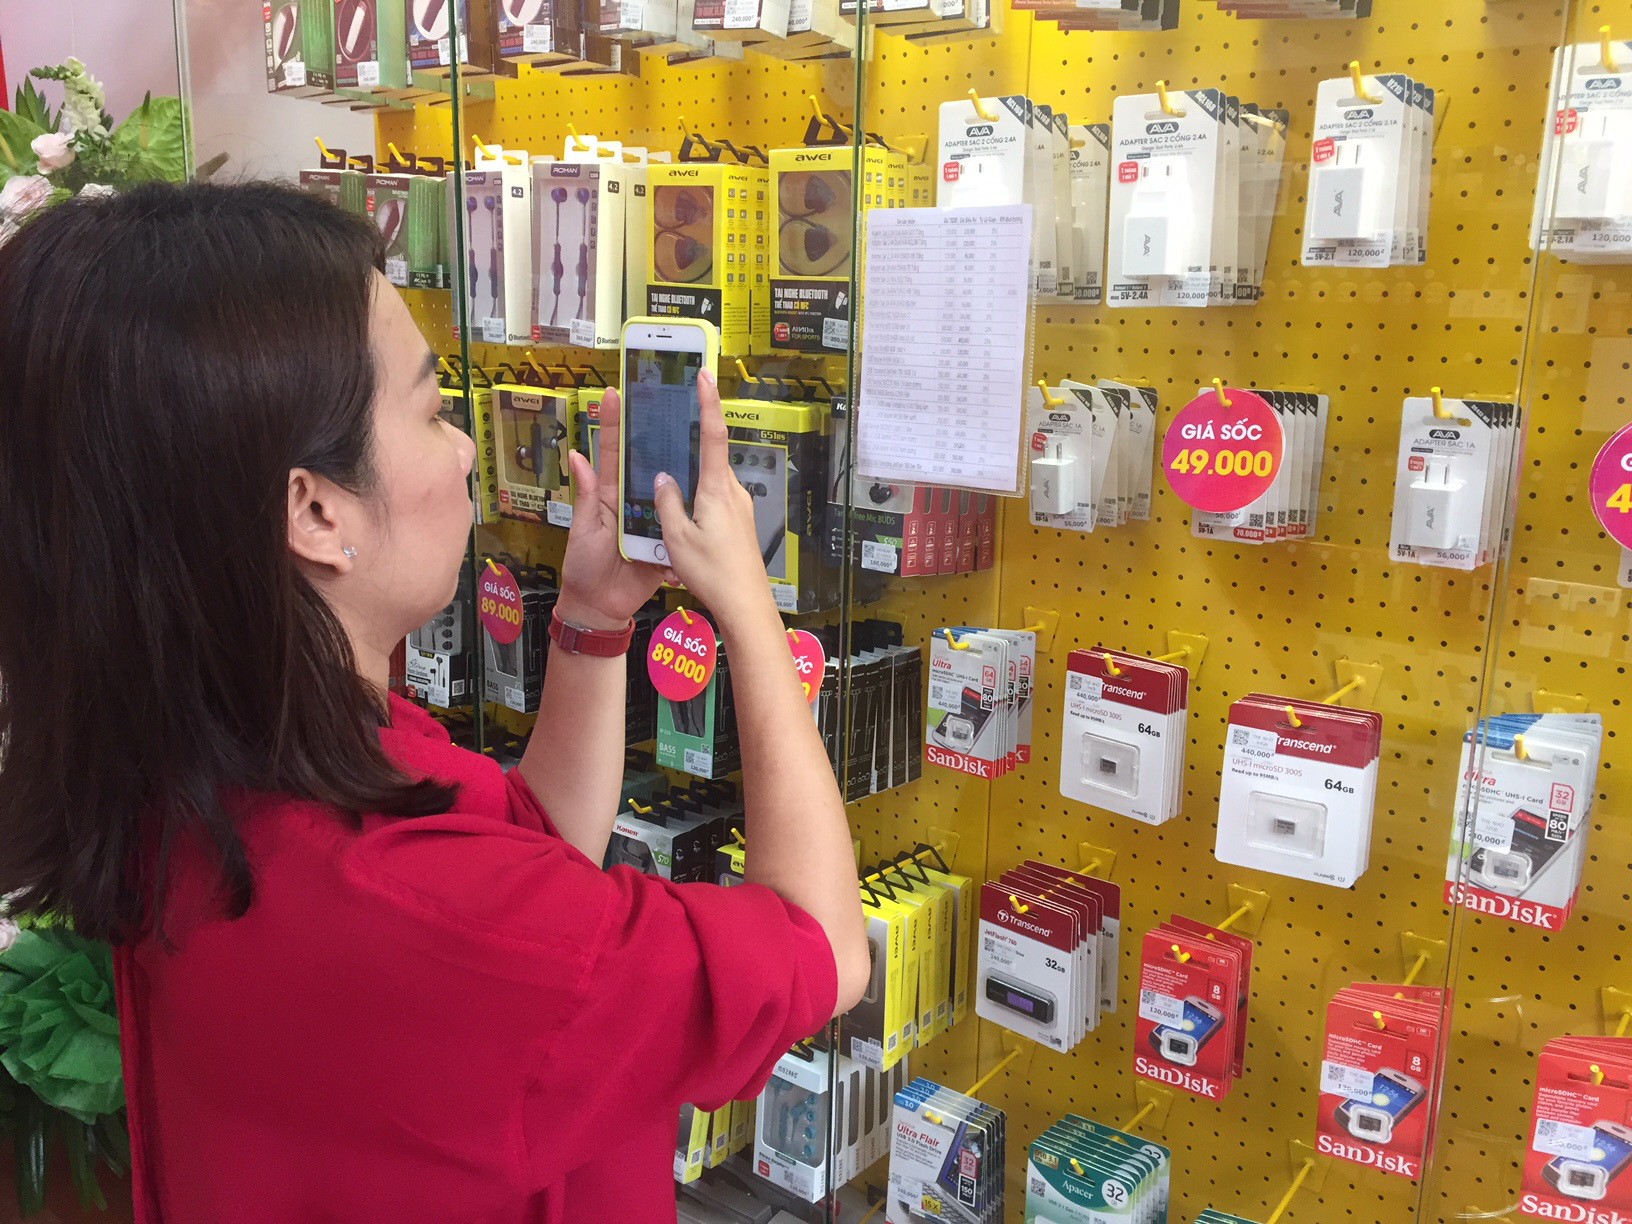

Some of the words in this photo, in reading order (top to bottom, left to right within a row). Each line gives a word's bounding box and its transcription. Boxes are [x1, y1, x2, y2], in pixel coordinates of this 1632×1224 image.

[1590, 79, 1617, 89] AVA
[1346, 110, 1370, 119] AVA
[969, 127, 989, 136] AVA
[1149, 124, 1176, 133] AVA
[1319, 122, 1344, 130] ADAPTER
[945, 139, 968, 148] ADAPTER
[1119, 136, 1148, 146] ADAPTER
[1577, 165, 1590, 194] AVA
[1334, 190, 1344, 217] AVA
[1592, 233, 1632, 243] 120,000
[1142, 234, 1150, 256] AVA
[1181, 420, 1215, 440] GIÁ
[1220, 418, 1262, 440] SỐC
[1433, 431, 1455, 439] AVA
[1413, 439, 1447, 447] ADAPTER
[1171, 449, 1273, 477] 49.000
[878, 515, 896, 525] BUDS
[1426, 507, 1435, 529] AVA
[484, 581, 499, 596] GIÁ
[500, 586, 516, 602] SỐC
[481, 597, 519, 625] 89.000
[664, 627, 684, 645] GIÁ
[684, 638, 707, 657] SỐC
[652, 643, 706, 683] 89.000
[792, 655, 814, 674] ỐC
[932, 659, 951, 670] Ultra
[486, 681, 499, 691] BASS
[983, 693, 993, 702] 80
[659, 743, 676, 754] BASS
[927, 747, 990, 778] SanDisk
[1232, 757, 1253, 767] UHS-I
[1253, 762, 1284, 773] microSD
[1285, 767, 1303, 776] 300S
[1324, 778, 1354, 794] 64GB
[1526, 796, 1544, 804] Card
[1555, 790, 1569, 800] 32
[1549, 819, 1566, 831] 80
[657, 855, 670, 864] S70
[1449, 884, 1553, 928] SanDisk
[1010, 915, 1053, 938] Transcend
[1175, 969, 1188, 979] Card
[1213, 985, 1220, 993] 8
[1328, 1033, 1362, 1045] microSDHC
[1367, 1041, 1382, 1050] Card
[1412, 1056, 1421, 1066] 8
[1135, 1057, 1216, 1098] SanDisk
[1539, 1087, 1577, 1098] microSDHC
[1583, 1094, 1599, 1102] Card
[905, 1100, 914, 1108] 3.0
[897, 1124, 918, 1138] Ultra
[919, 1133, 940, 1147] Flair
[964, 1157, 974, 1166] 32
[1318, 1135, 1414, 1177] SanDisk
[1062, 1180, 1093, 1200] Apacer
[1107, 1183, 1124, 1202] 32
[1522, 1194, 1628, 1224] SanDisk
